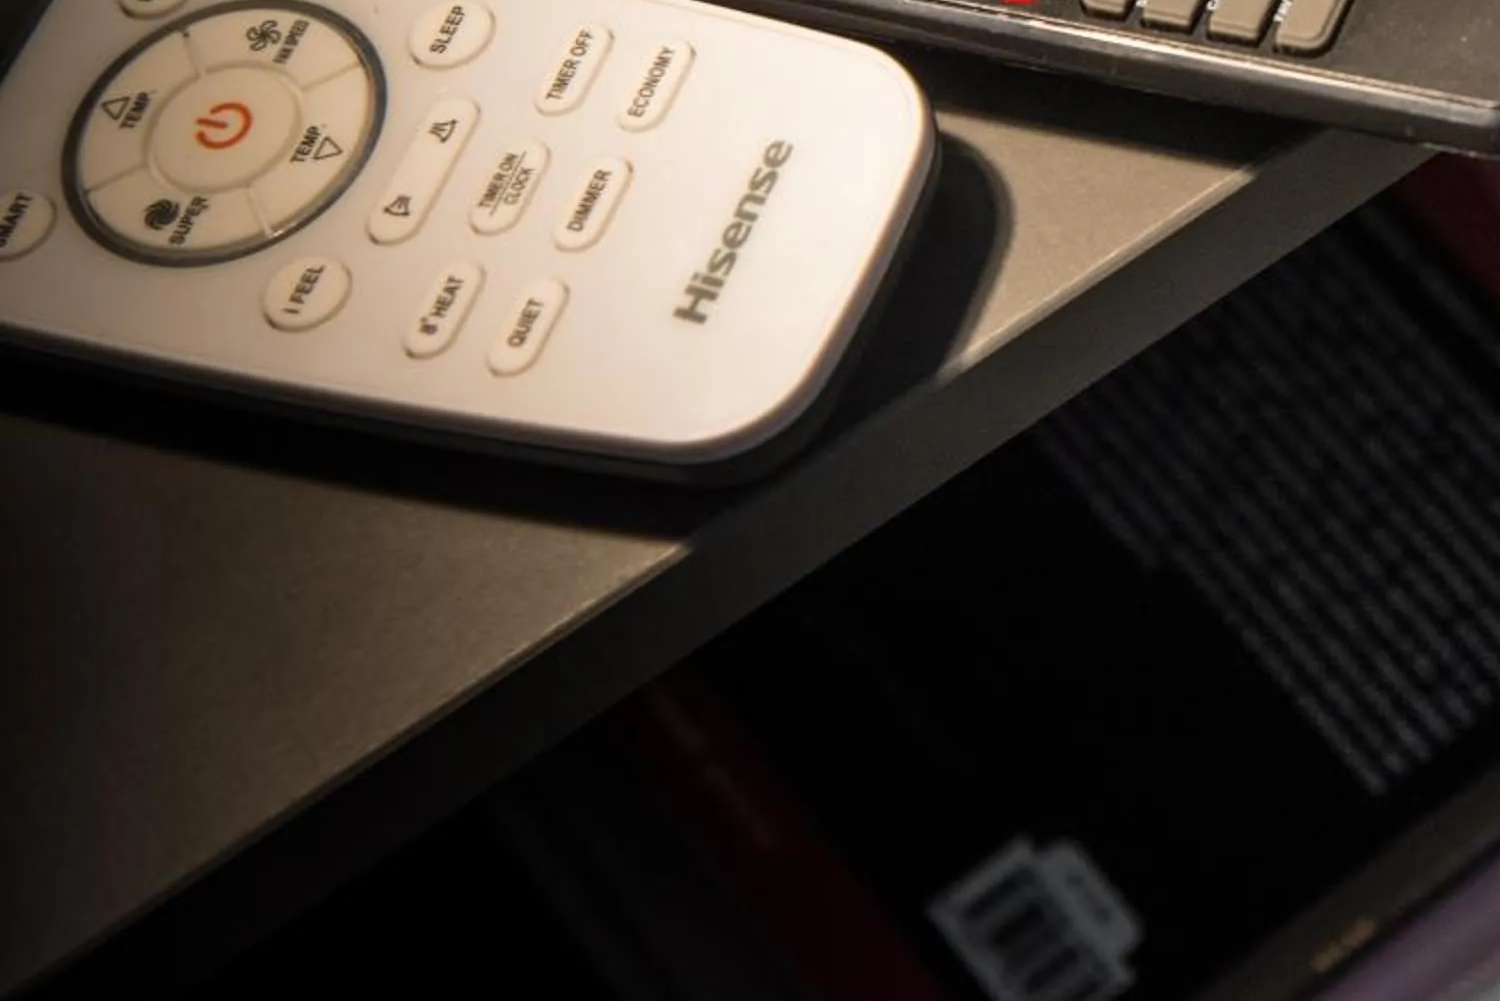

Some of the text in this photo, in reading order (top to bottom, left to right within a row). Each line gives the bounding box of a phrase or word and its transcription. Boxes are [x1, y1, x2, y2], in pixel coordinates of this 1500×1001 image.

[428, 4, 466, 55] SLEEP
[545, 28, 595, 101] TIMER OFF
[627, 45, 677, 119] ECONOMY
[477, 152, 519, 211] TIMER ON
[502, 166, 535, 207] CLOCK
[566, 168, 612, 233] DIMMER
[168, 195, 210, 246] SUPER
[672, 138, 795, 327] Hisense
[288, 264, 325, 307] FEEL
[430, 274, 466, 319] HEAT
[506, 297, 545, 350] QUIET
